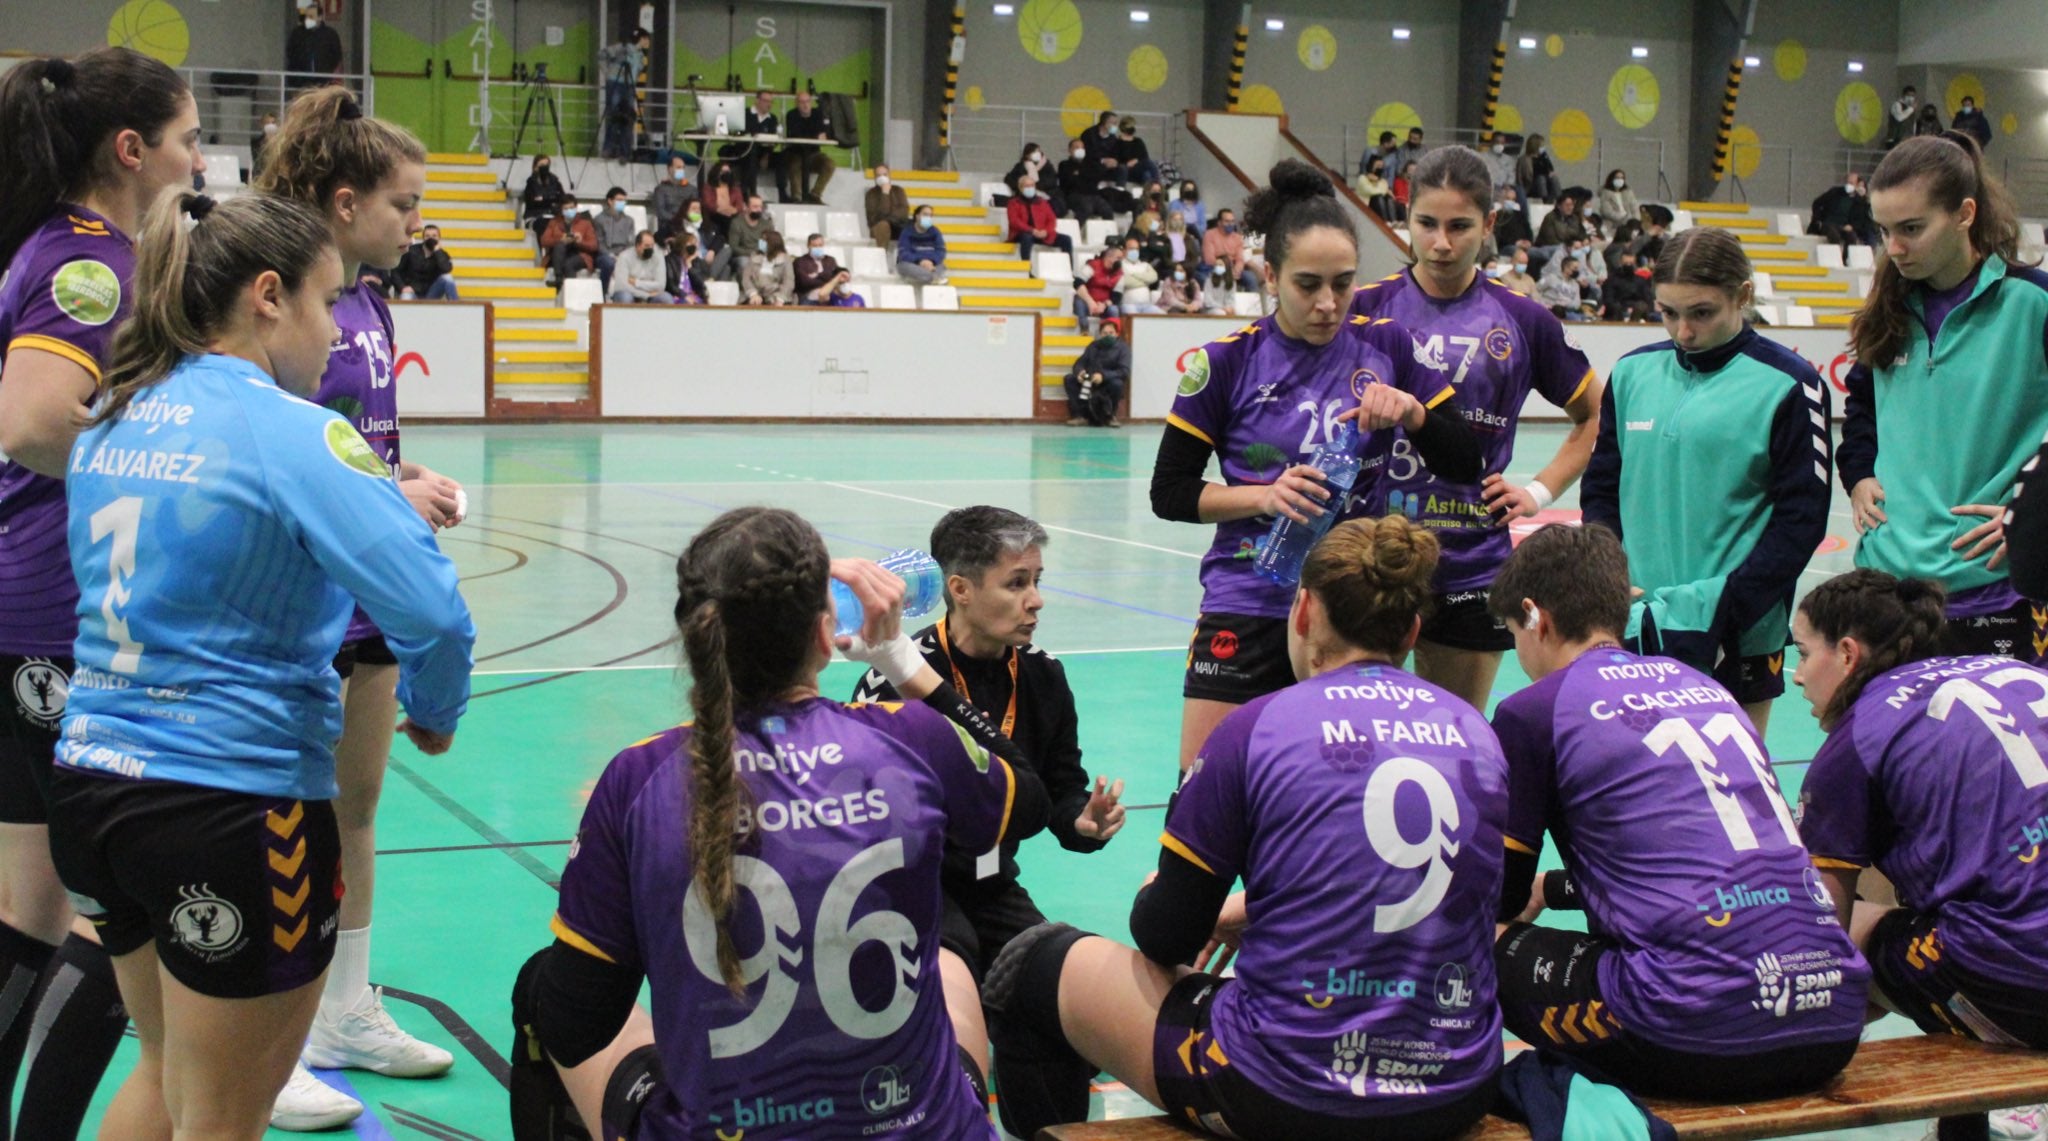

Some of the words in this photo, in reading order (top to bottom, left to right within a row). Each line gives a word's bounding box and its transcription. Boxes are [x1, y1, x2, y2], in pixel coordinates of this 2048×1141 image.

[354, 330, 391, 390] 15
[1421, 333, 1481, 384] 47
[1297, 398, 1347, 454] 26
[71, 446, 85, 473] R.
[87, 439, 206, 484] ÁLVAREZ
[90, 495, 145, 674] 1
[1589, 700, 1624, 721] C.
[1885, 682, 1923, 710] M.
[1321, 719, 1368, 745] M.
[1372, 719, 1468, 749] FARIA
[89, 746, 147, 780] SPAIN
[1641, 712, 1804, 852] 11
[1362, 756, 1461, 934] 9
[1715, 883, 1791, 911] blinca
[682, 836, 923, 1060] 96
[1326, 967, 1417, 999] blinca
[1795, 969, 1842, 992] SPAIN
[1795, 989, 1832, 1011] 2021
[1429, 1017, 1463, 1029] CLINICA
[1375, 1058, 1444, 1076] SPAIN
[1375, 1077, 1428, 1095] 2021
[734, 1097, 836, 1128] blinca
[862, 1118, 907, 1136] CLINICA
